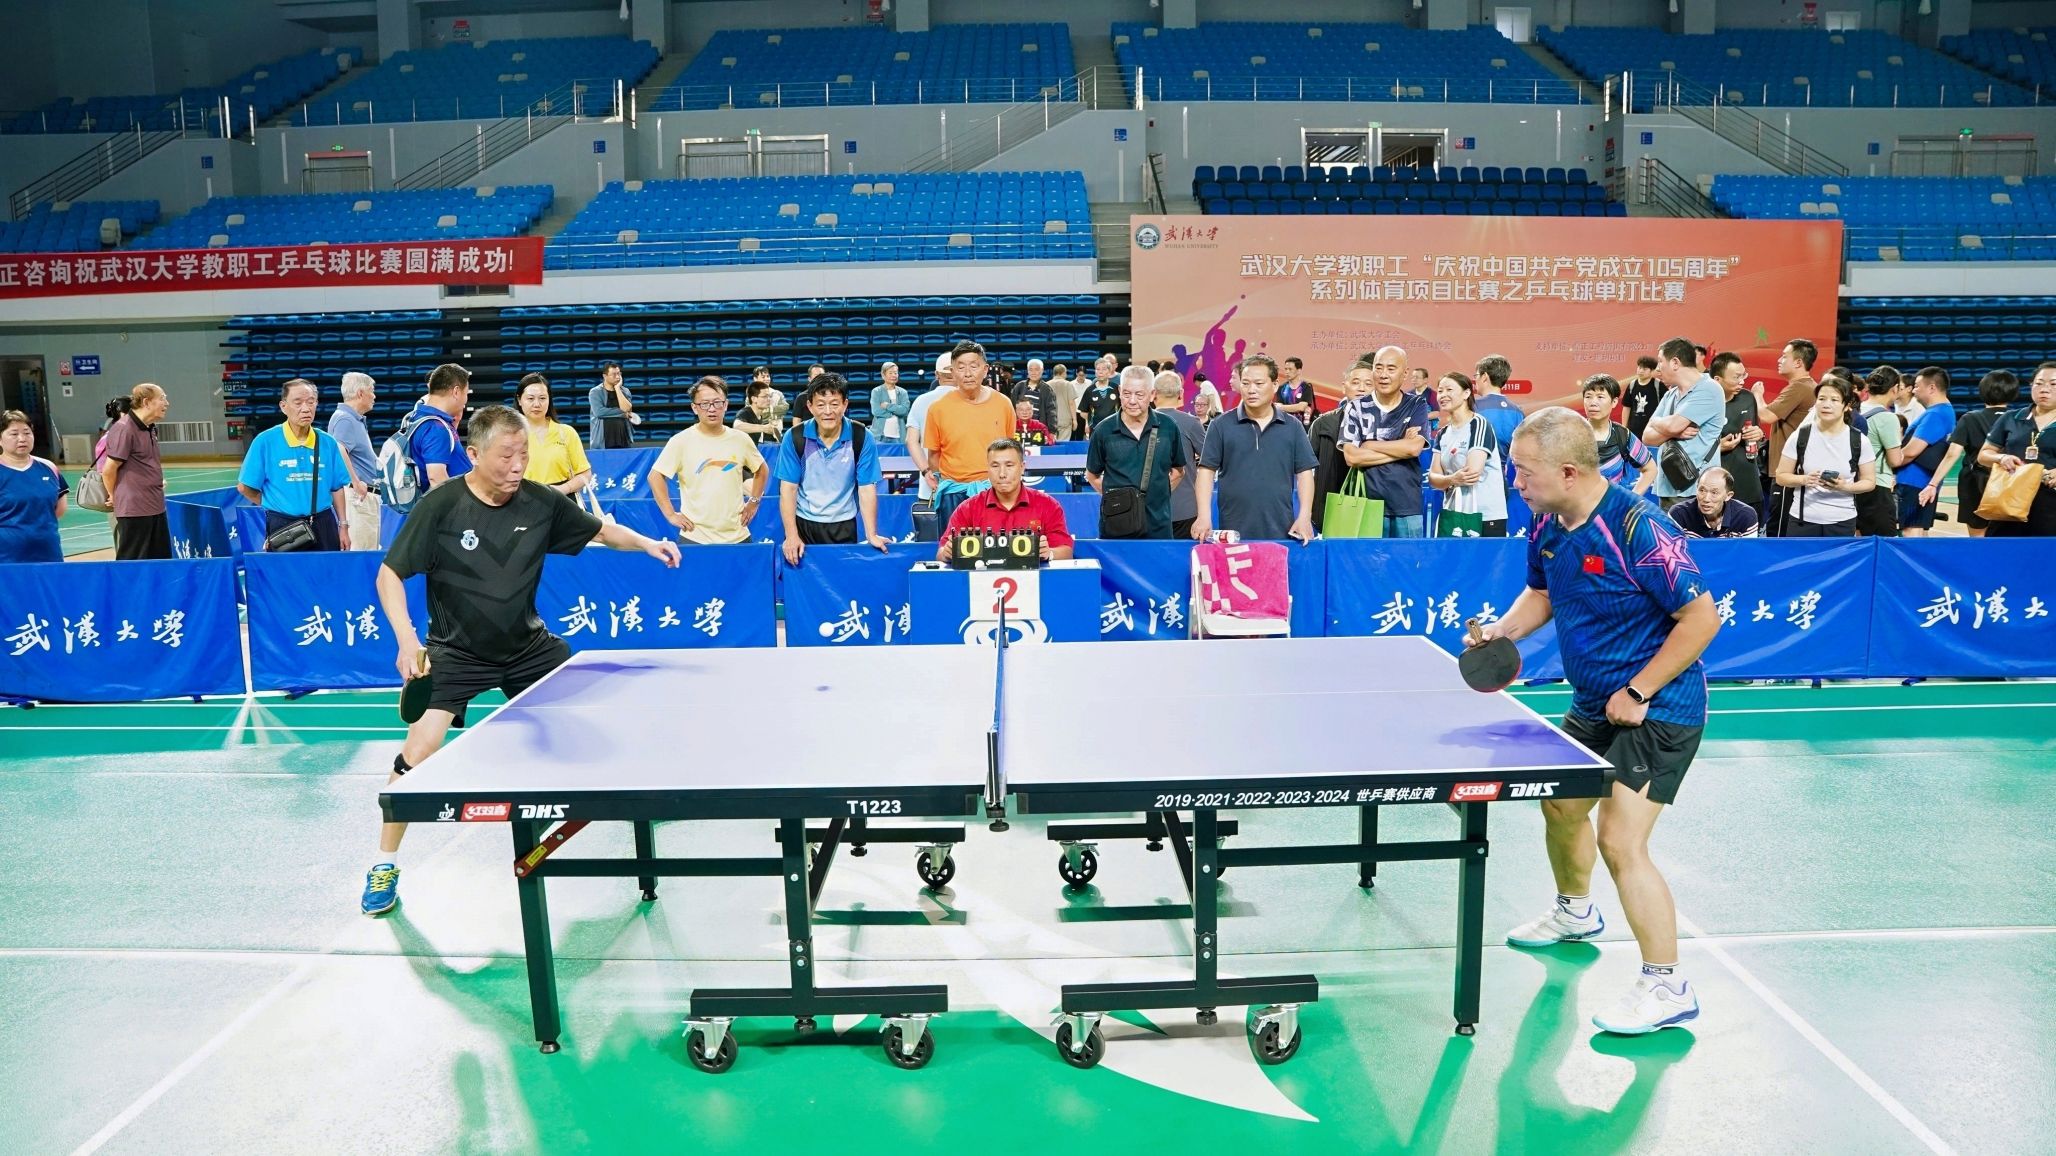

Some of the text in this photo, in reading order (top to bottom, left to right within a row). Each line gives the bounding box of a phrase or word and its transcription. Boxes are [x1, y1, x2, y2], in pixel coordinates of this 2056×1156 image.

[1310, 279, 1686, 301] 系列体育项目比赛之乒乓球单打比赛
[1032, 432, 1042, 443] 4
[961, 536, 1032, 557] 0 0 0 0
[993, 577, 1019, 613] 2
[1356, 786, 1438, 802] 世乒赛供应商
[1509, 782, 1560, 797] DHS
[518, 804, 570, 819] DHS
[846, 800, 902, 814] T1223
